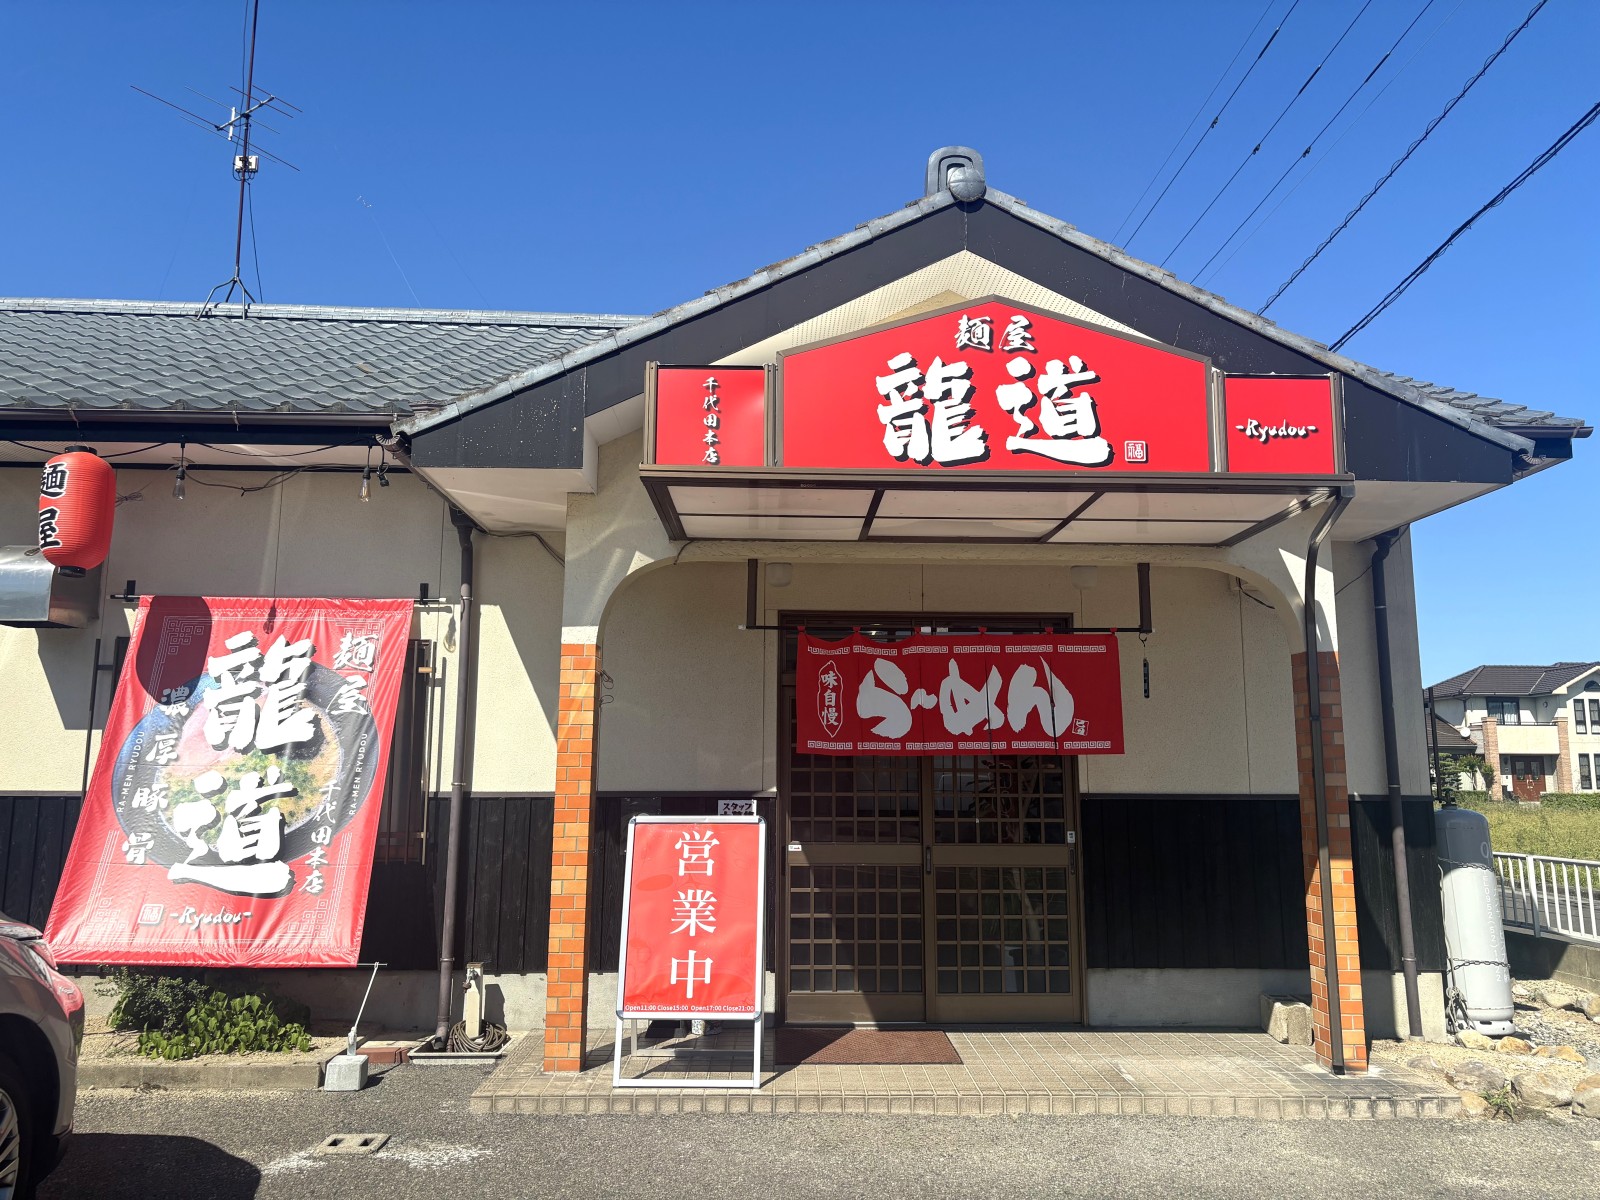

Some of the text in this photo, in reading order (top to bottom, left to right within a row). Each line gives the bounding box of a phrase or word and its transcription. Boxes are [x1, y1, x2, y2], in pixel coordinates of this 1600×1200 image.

[954, 314, 1035, 351] 麺屋
[702, 376, 719, 463] 千代田本店
[876, 352, 1111, 464] 龍道
[1125, 441, 1145, 461] 福
[326, 632, 379, 715] 麺屋
[821, 671, 839, 726] 味自慢
[117, 731, 145, 813] RA-MEN RYUDOU
[122, 686, 190, 864] 濃厚豚骨
[168, 630, 318, 895] 龍道
[349, 733, 368, 815] RA-MEN RYUDOU
[298, 780, 341, 893] 千代田本店
[723, 802, 752, 811] スタッフ
[138, 904, 164, 924] 福
[669, 830, 720, 999] 営業中
